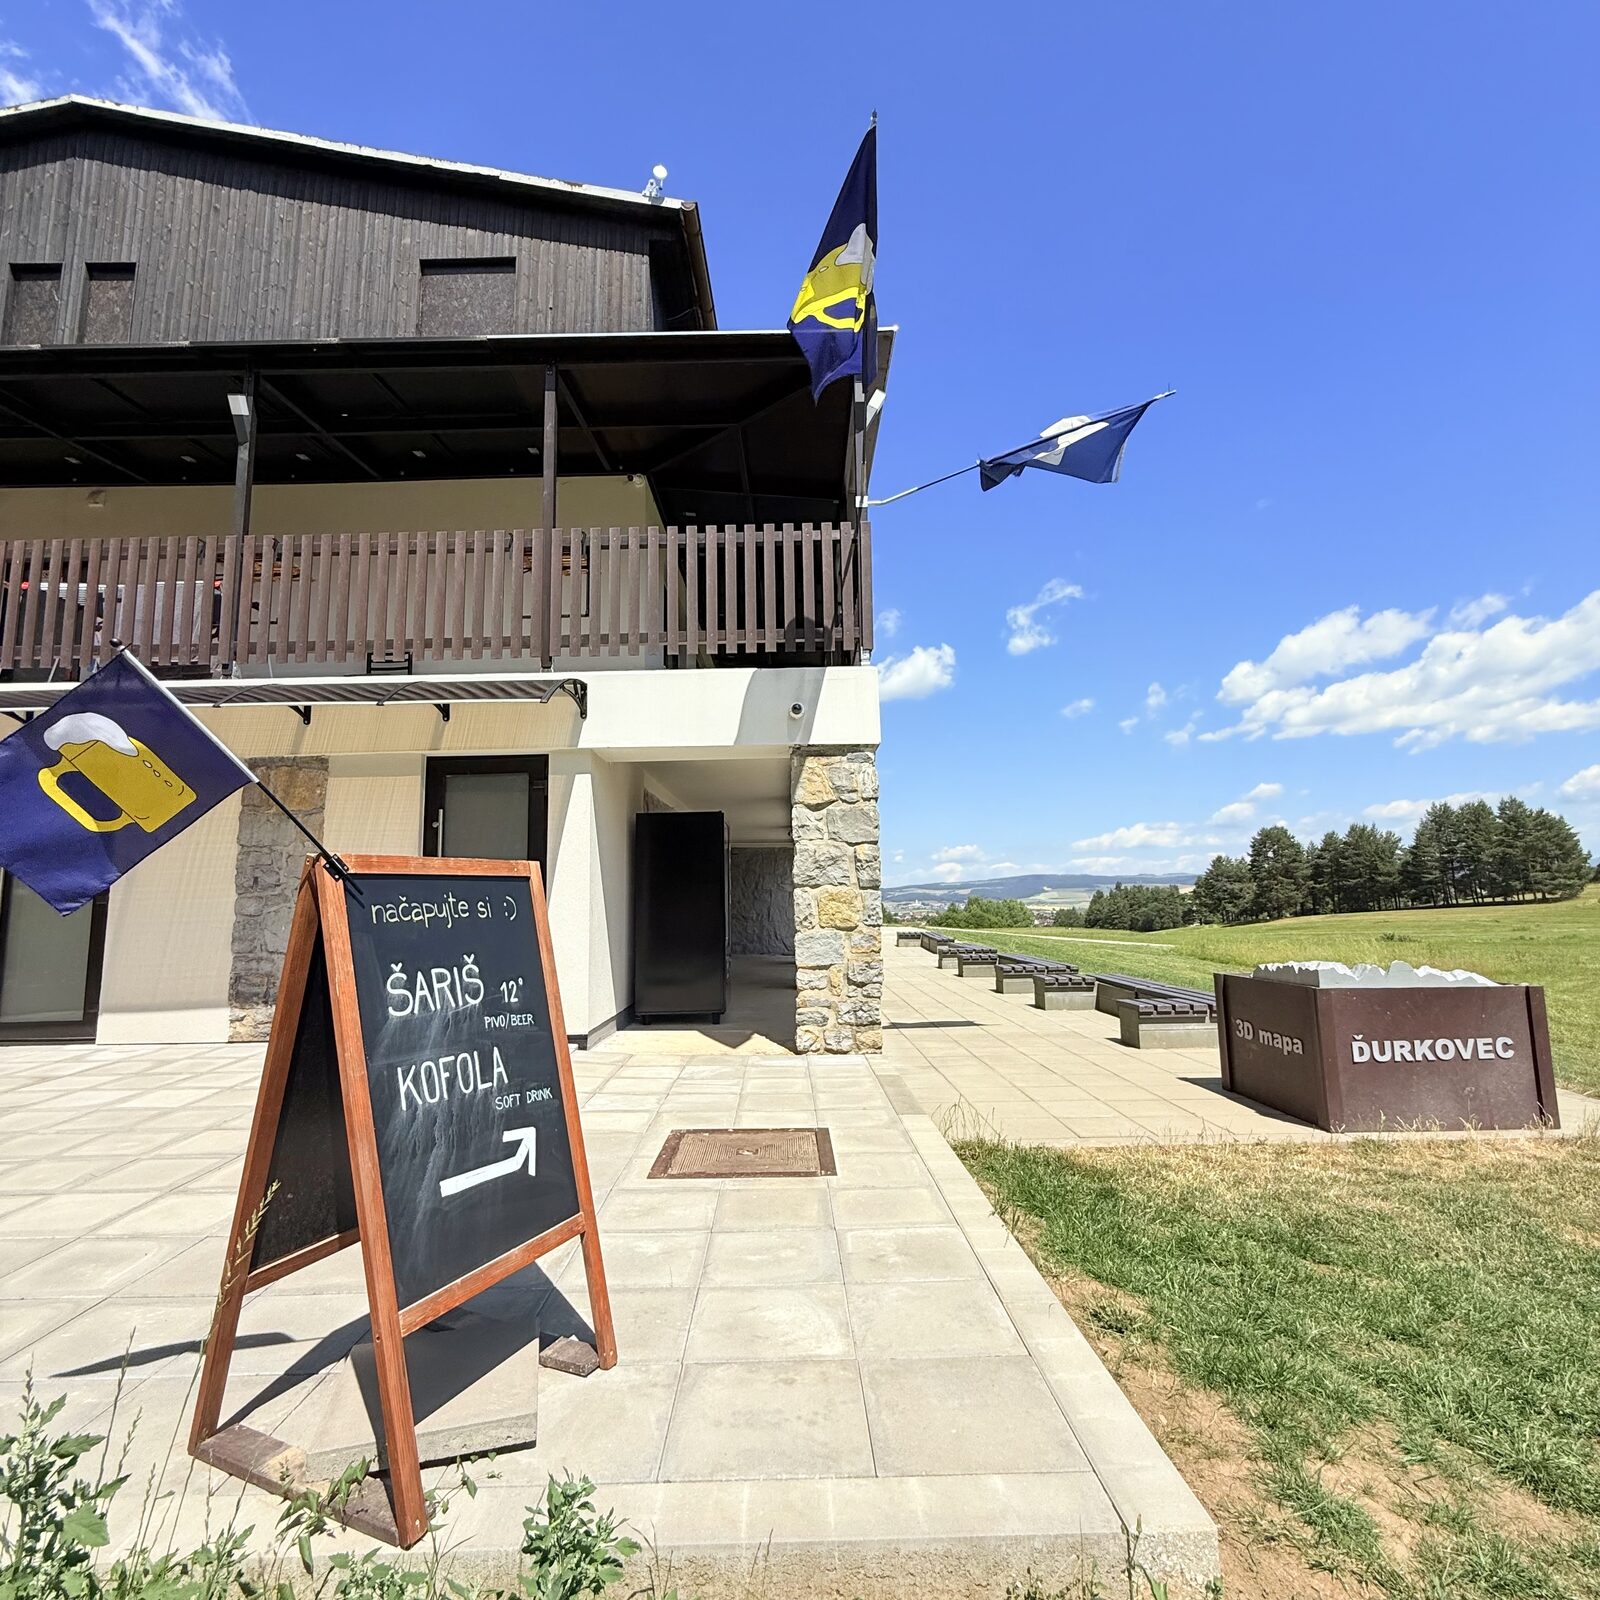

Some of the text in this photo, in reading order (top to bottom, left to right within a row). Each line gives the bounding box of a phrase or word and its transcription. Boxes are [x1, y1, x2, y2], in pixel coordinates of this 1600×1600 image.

[371, 892, 469, 928] načapujte
[477, 896, 492, 919] si
[386, 953, 524, 1017] ŠARIŠ 12°
[484, 1013, 535, 1029] PIVO/BEER
[1235, 1018, 1304, 1055] 3D mapa
[1351, 1034, 1515, 1064] ĎURKOVEC
[397, 1046, 509, 1111] KOFOLA
[495, 1087, 553, 1110] SOFT DRINK
